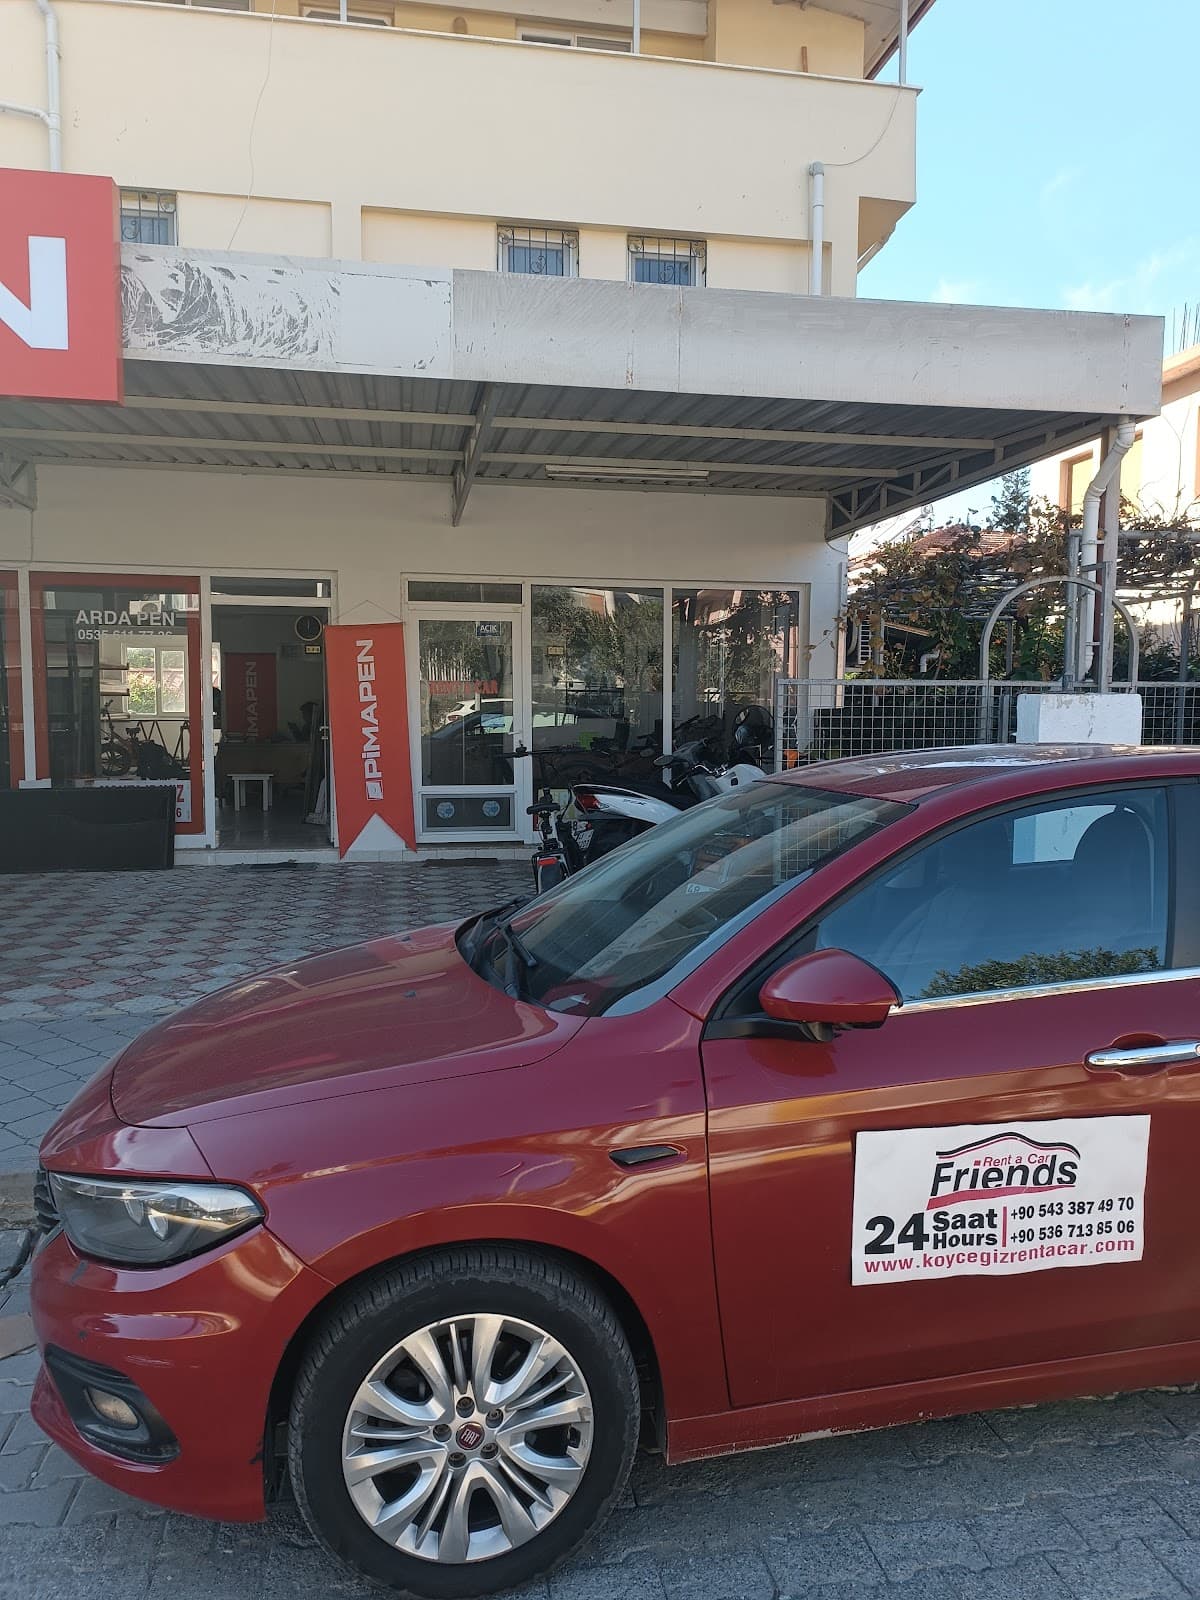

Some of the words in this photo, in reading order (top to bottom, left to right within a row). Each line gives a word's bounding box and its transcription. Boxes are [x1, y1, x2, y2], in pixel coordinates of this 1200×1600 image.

[76, 610, 132, 625] ARDA
[137, 611, 175, 626] PEN
[983, 1155, 1011, 1167] Rent
[1015, 1156, 1022, 1164] a
[1027, 1153, 1050, 1165] Car
[930, 1155, 1078, 1197] Friends
[932, 1208, 998, 1232] Saat
[1011, 1205, 1035, 1220] +90
[1038, 1202, 1064, 1218] 543
[1067, 1201, 1094, 1215] 387
[1098, 1198, 1113, 1212] 49
[1118, 1196, 1135, 1211] 70
[864, 1212, 930, 1255] 24
[932, 1232, 998, 1250] Hours
[1011, 1228, 1035, 1243] +90
[1038, 1224, 1063, 1240] 536
[1067, 1223, 1094, 1238] 713
[1097, 1220, 1113, 1234] 85
[1117, 1219, 1135, 1234] 06
[864, 1239, 1135, 1273] www.koycegizrentacar.com
[460, 1428, 480, 1445] FIAT
